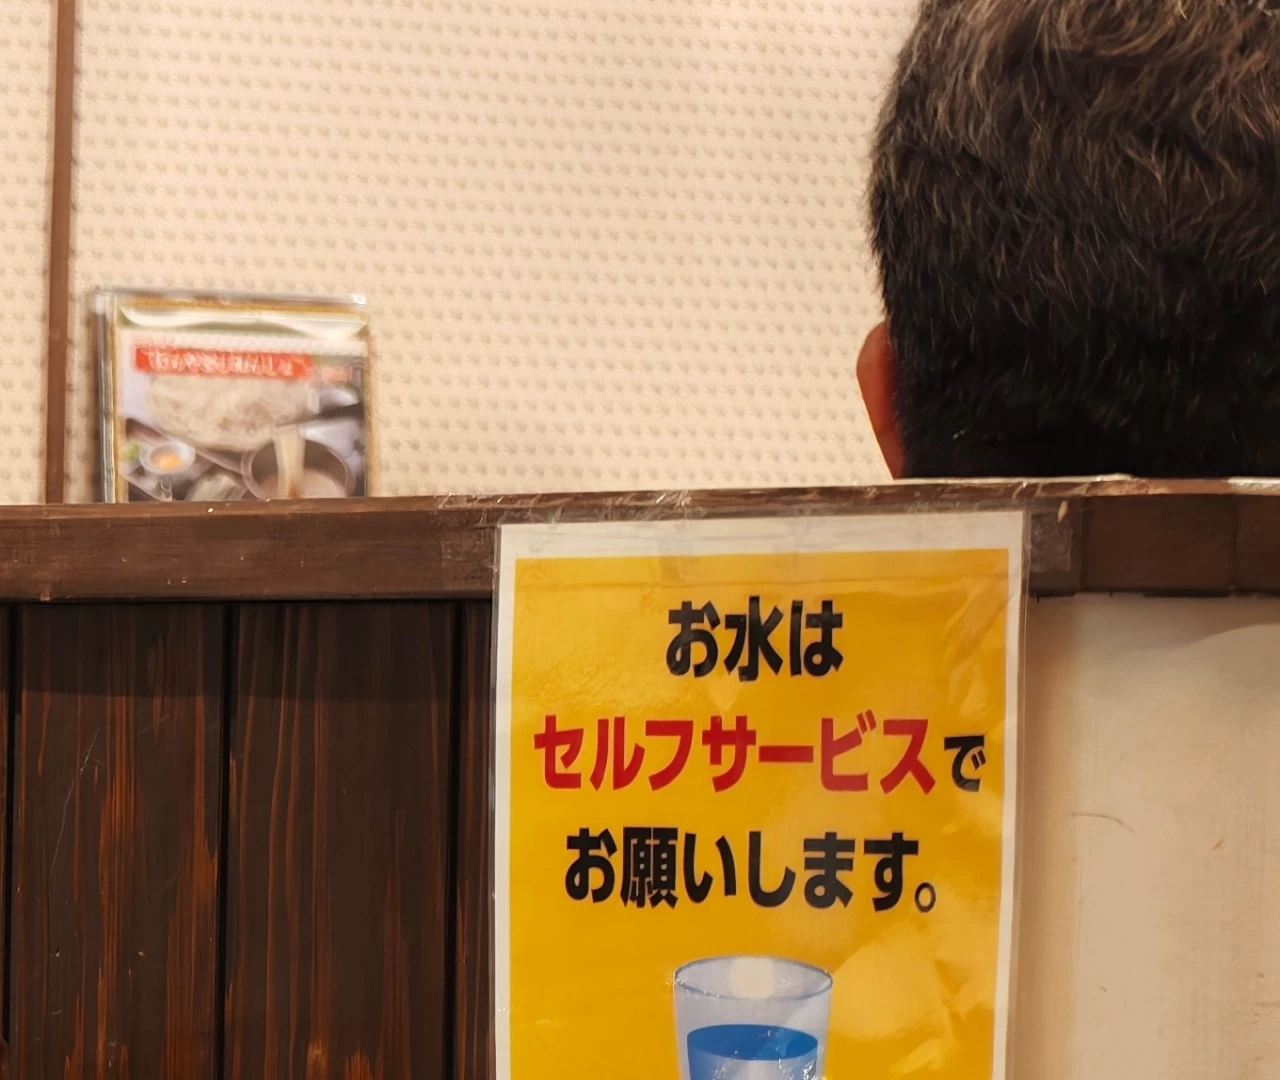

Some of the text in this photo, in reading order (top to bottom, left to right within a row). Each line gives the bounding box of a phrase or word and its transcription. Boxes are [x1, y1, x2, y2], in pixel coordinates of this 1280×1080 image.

[665, 595, 844, 682] お水は
[533, 708, 987, 796] セルフサービスで
[564, 825, 937, 914] お願いします。
